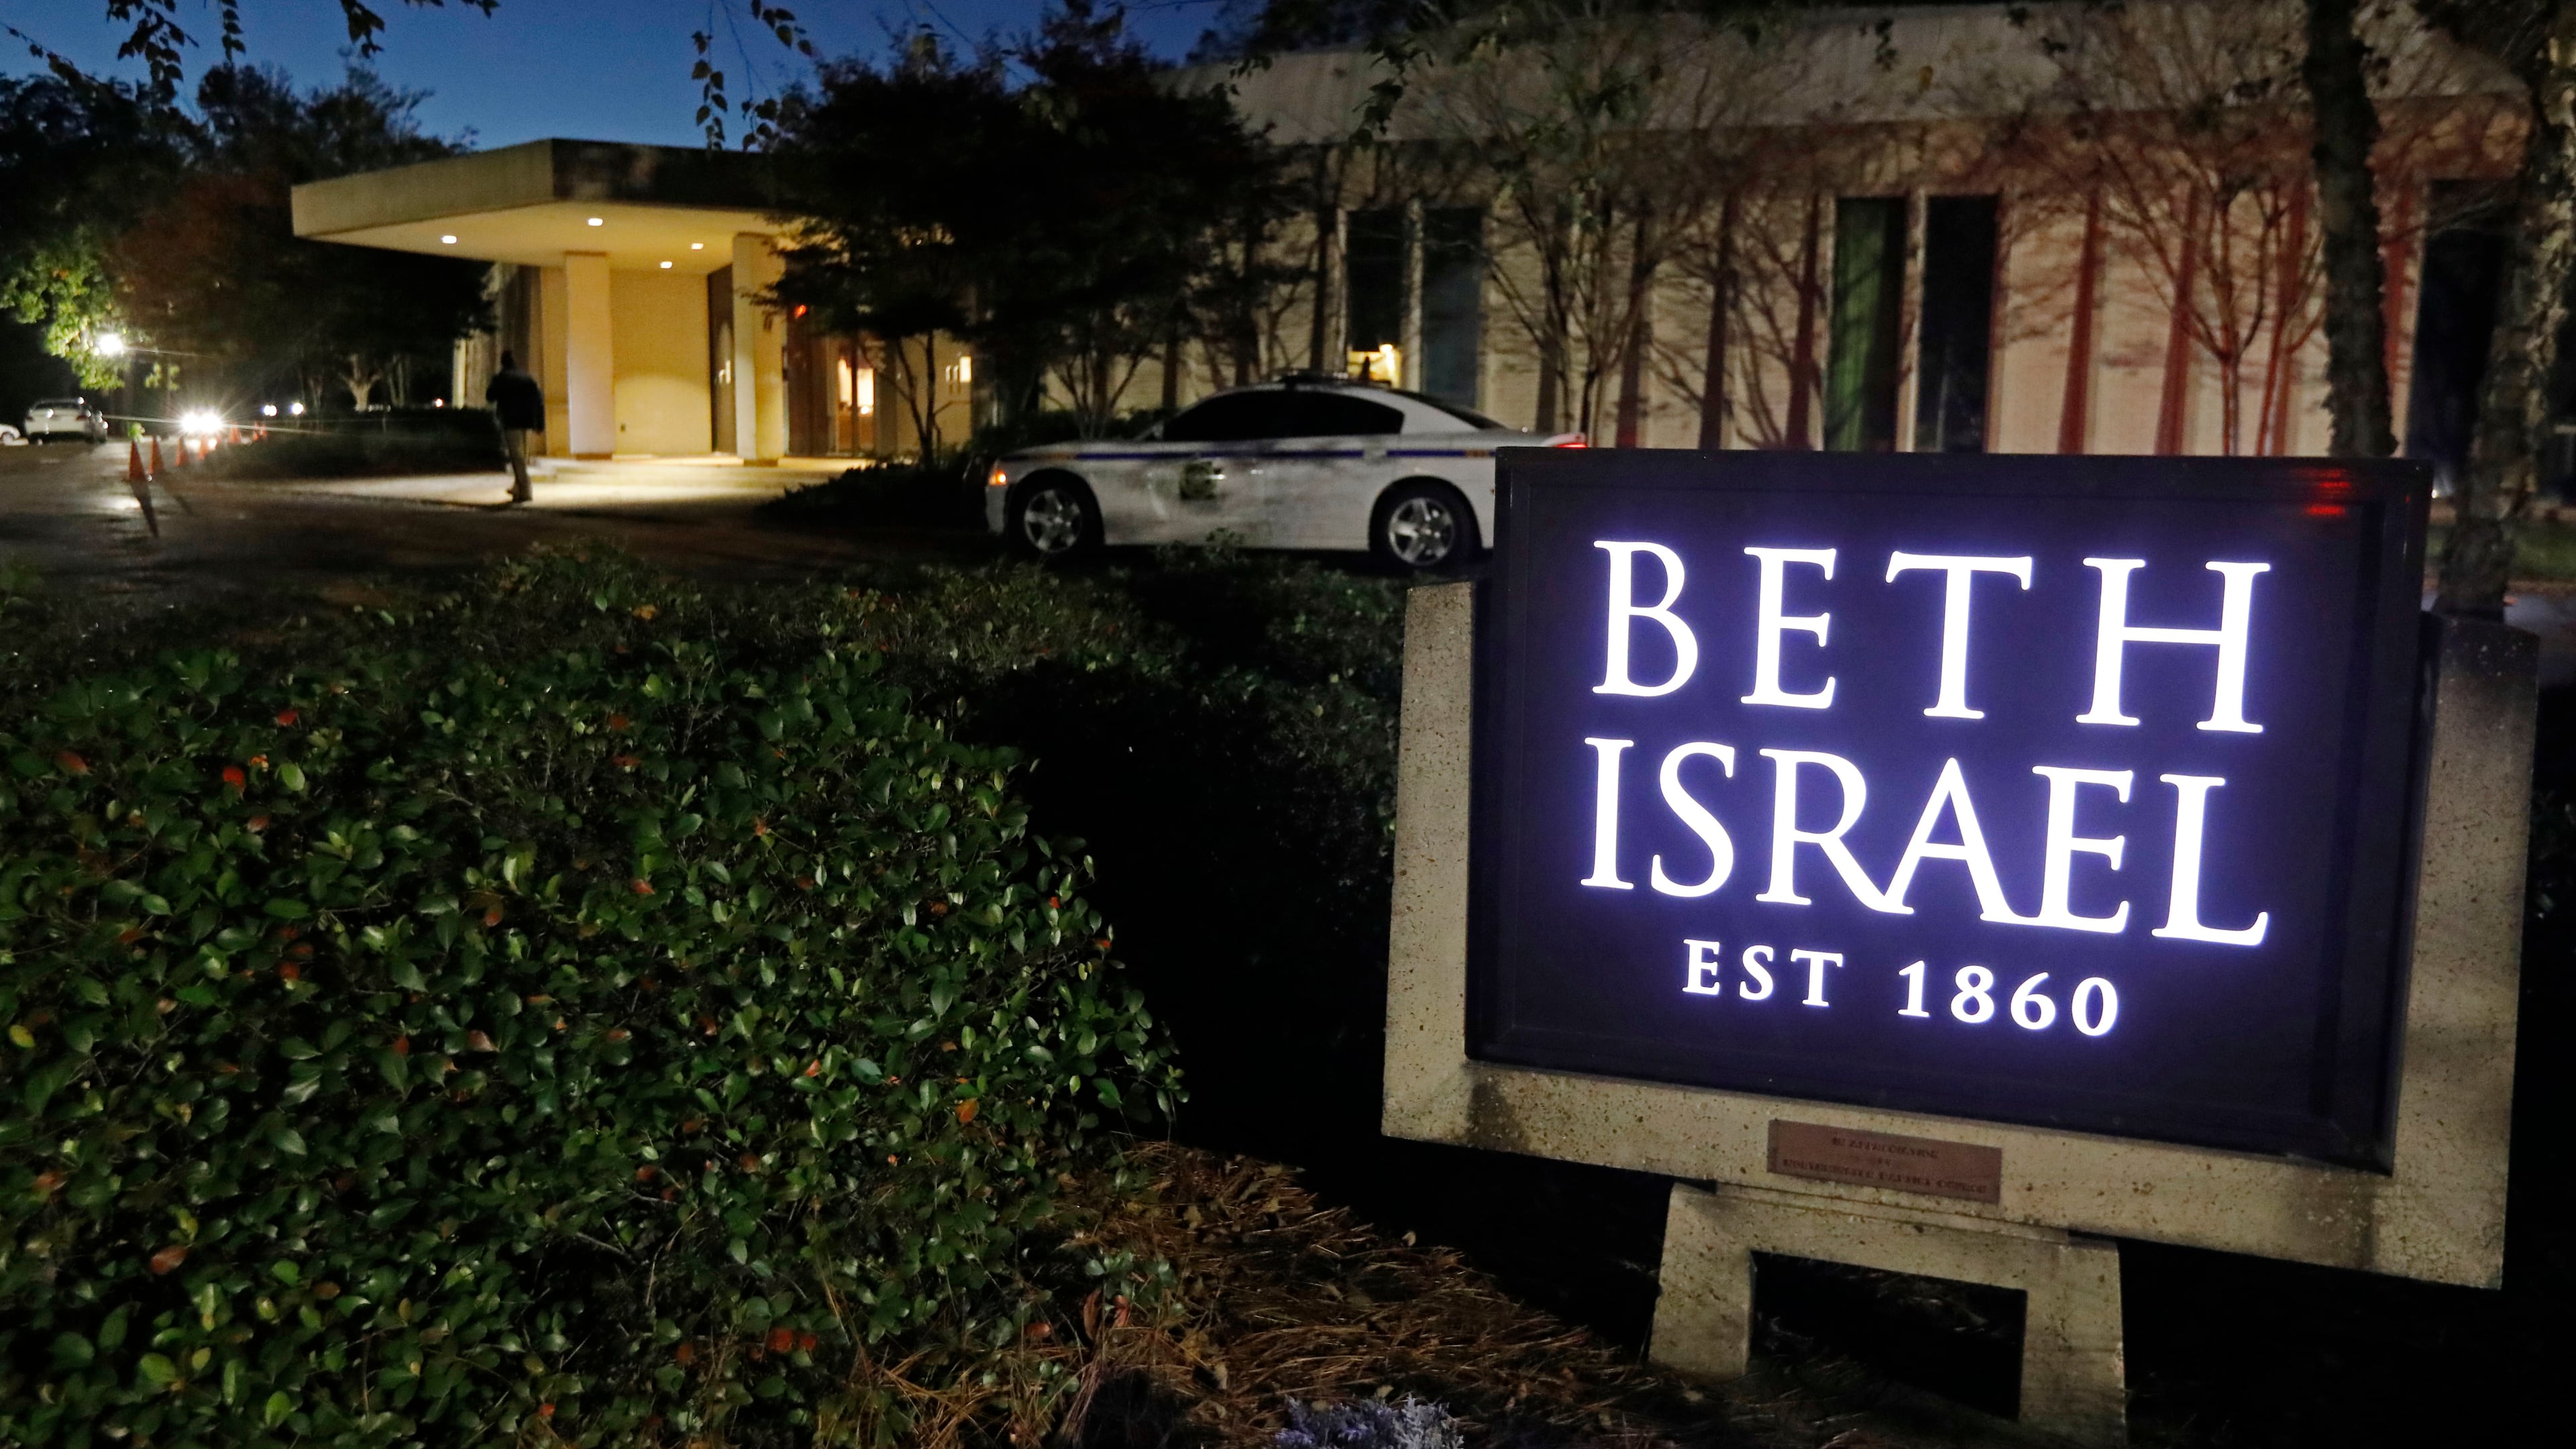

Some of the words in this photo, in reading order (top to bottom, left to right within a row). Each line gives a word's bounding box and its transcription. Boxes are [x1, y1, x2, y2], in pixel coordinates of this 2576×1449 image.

[1591, 539, 2273, 735] BETH
[1578, 736, 2270, 948] ISRAEL
[1681, 938, 1845, 1009] EST
[1896, 959, 2121, 1038] 1860
